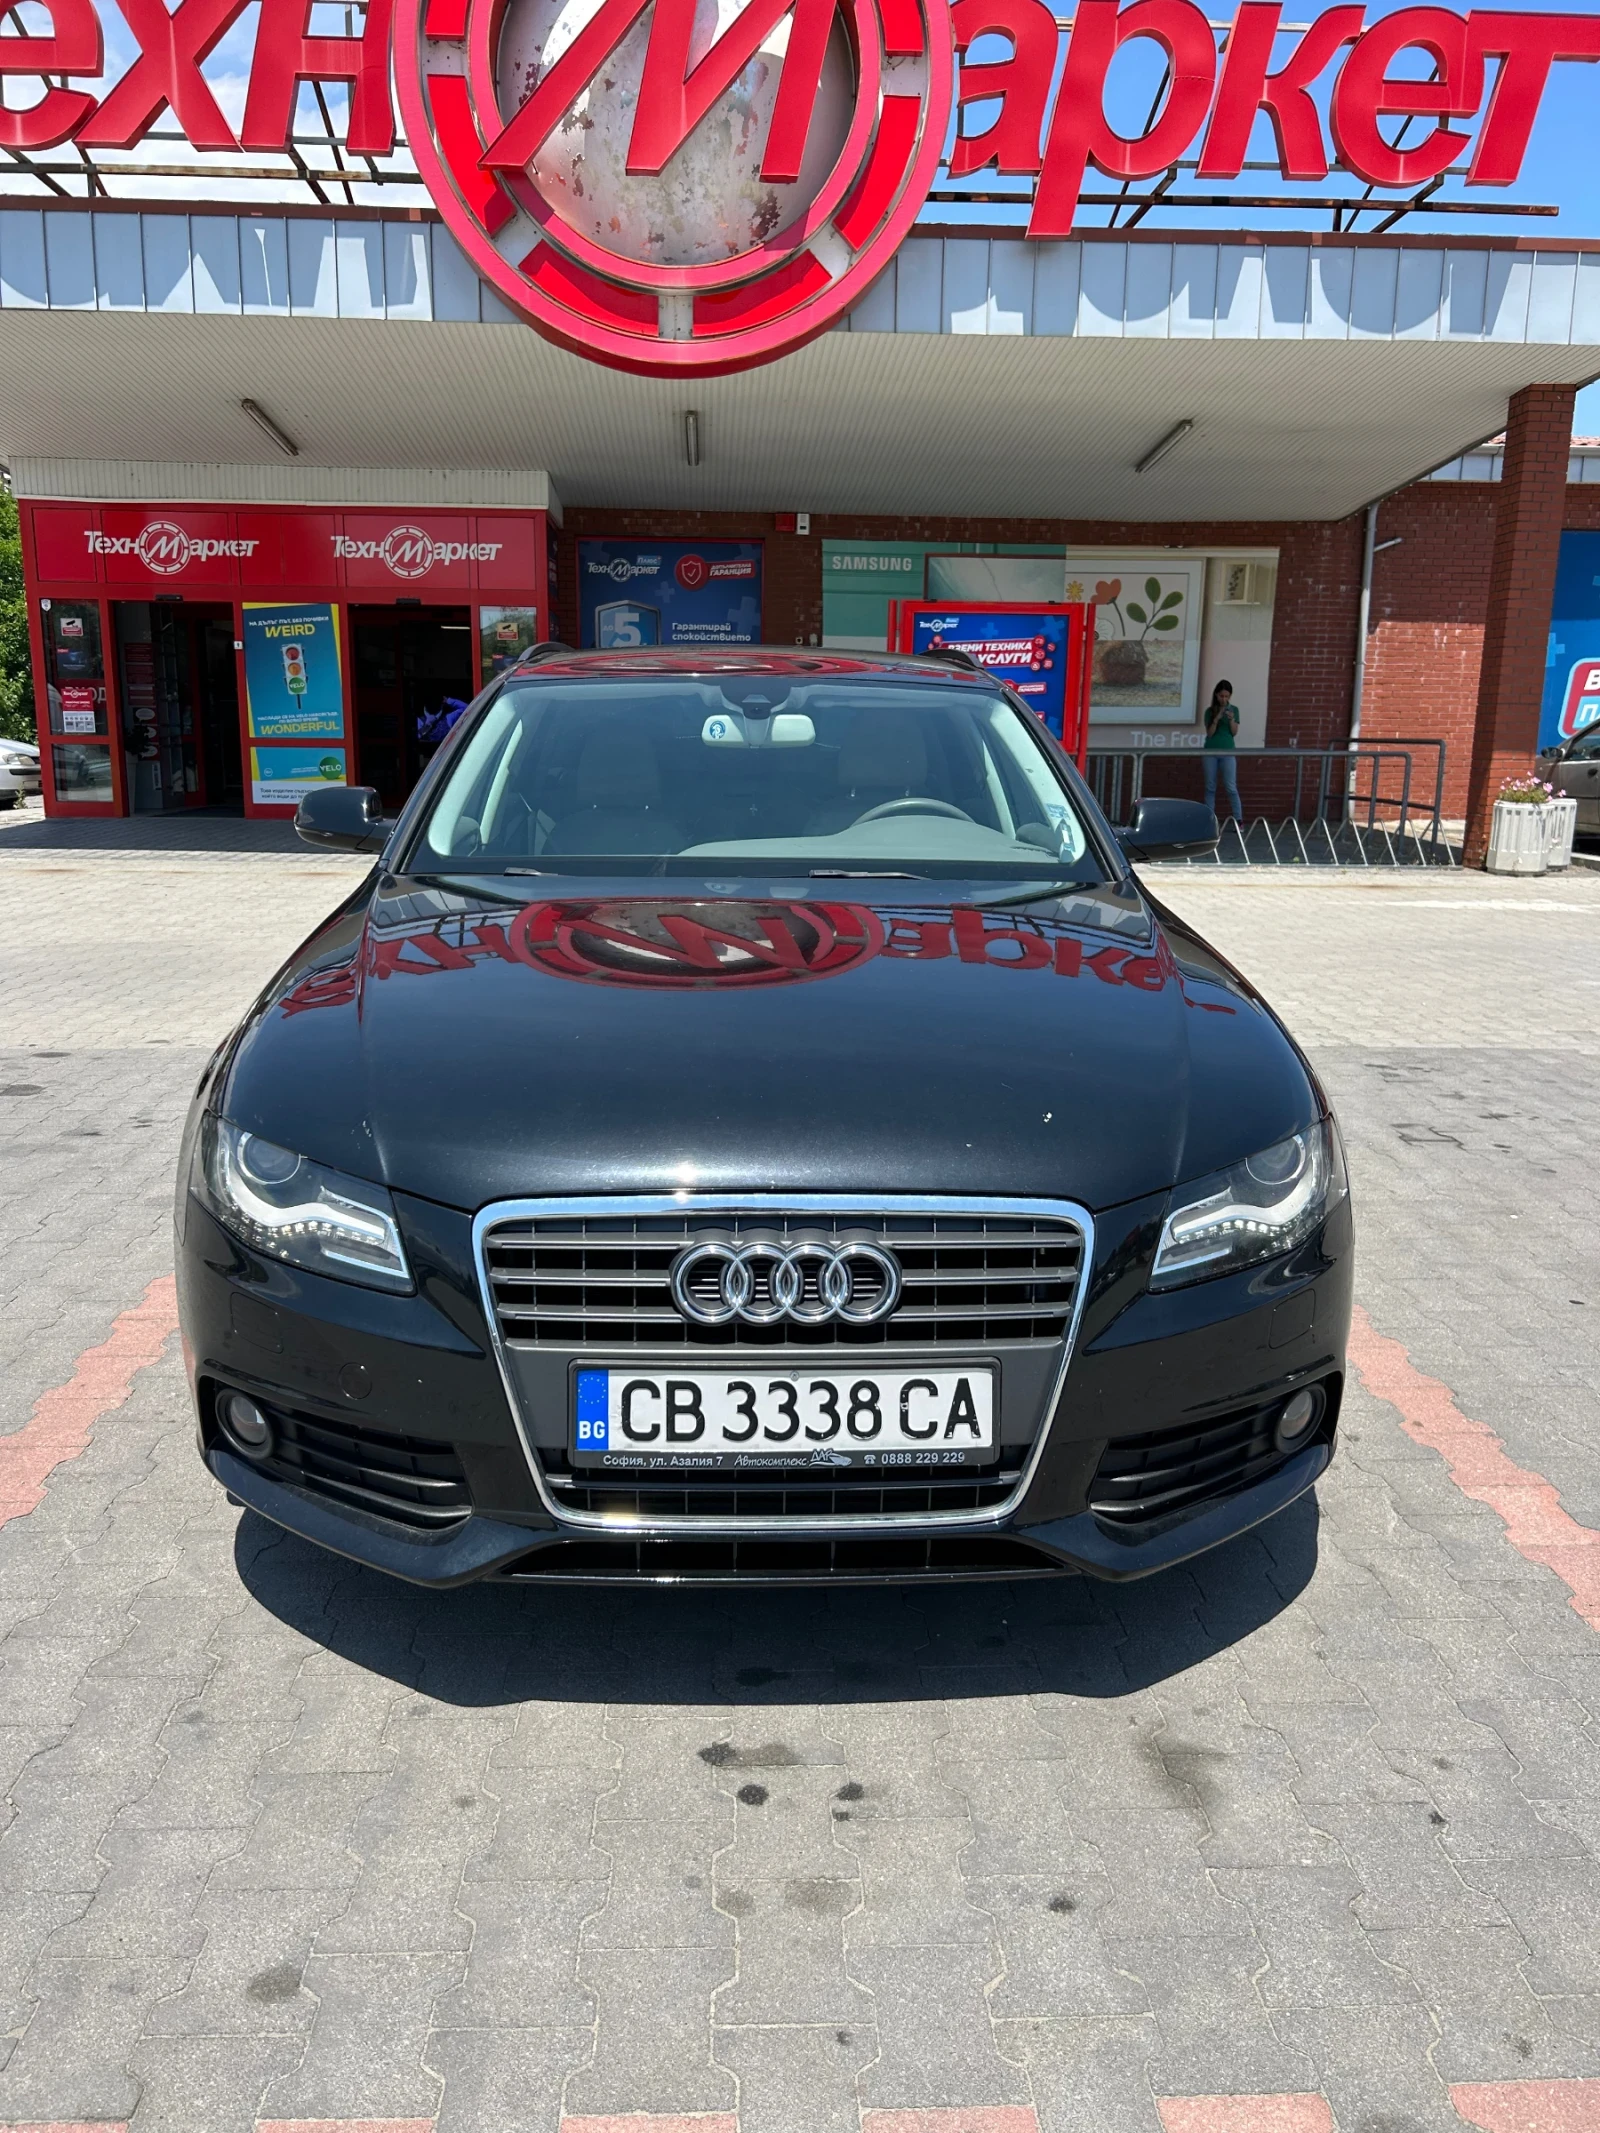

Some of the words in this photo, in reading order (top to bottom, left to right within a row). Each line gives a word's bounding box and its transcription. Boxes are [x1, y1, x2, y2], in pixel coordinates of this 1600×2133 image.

[832, 556, 912, 571] SAMSUNG
[265, 623, 316, 638] WEIRD
[614, 612, 641, 647] 5
[672, 622, 731, 633] Гарантирай
[672, 632, 751, 642] спокойствието
[985, 642, 1032, 652] ТЕХНИКА
[978, 653, 1032, 664] УСЛУГИ
[261, 721, 340, 735] WONDERFUL
[1131, 731, 1166, 747] The
[320, 764, 342, 772] VELO
[579, 1420, 606, 1440] BG
[621, 1379, 706, 1442] CB
[722, 1379, 882, 1442] 3338
[900, 1378, 981, 1440] CA
[603, 1455, 647, 1467] София,
[649, 1457, 667, 1468] ул.
[670, 1455, 713, 1466] Азалия
[716, 1456, 723, 1466] 7
[734, 1454, 808, 1467] Автокомплекс
[881, 1453, 912, 1464] 0888
[916, 1452, 939, 1464] 229
[943, 1452, 966, 1463] 229
